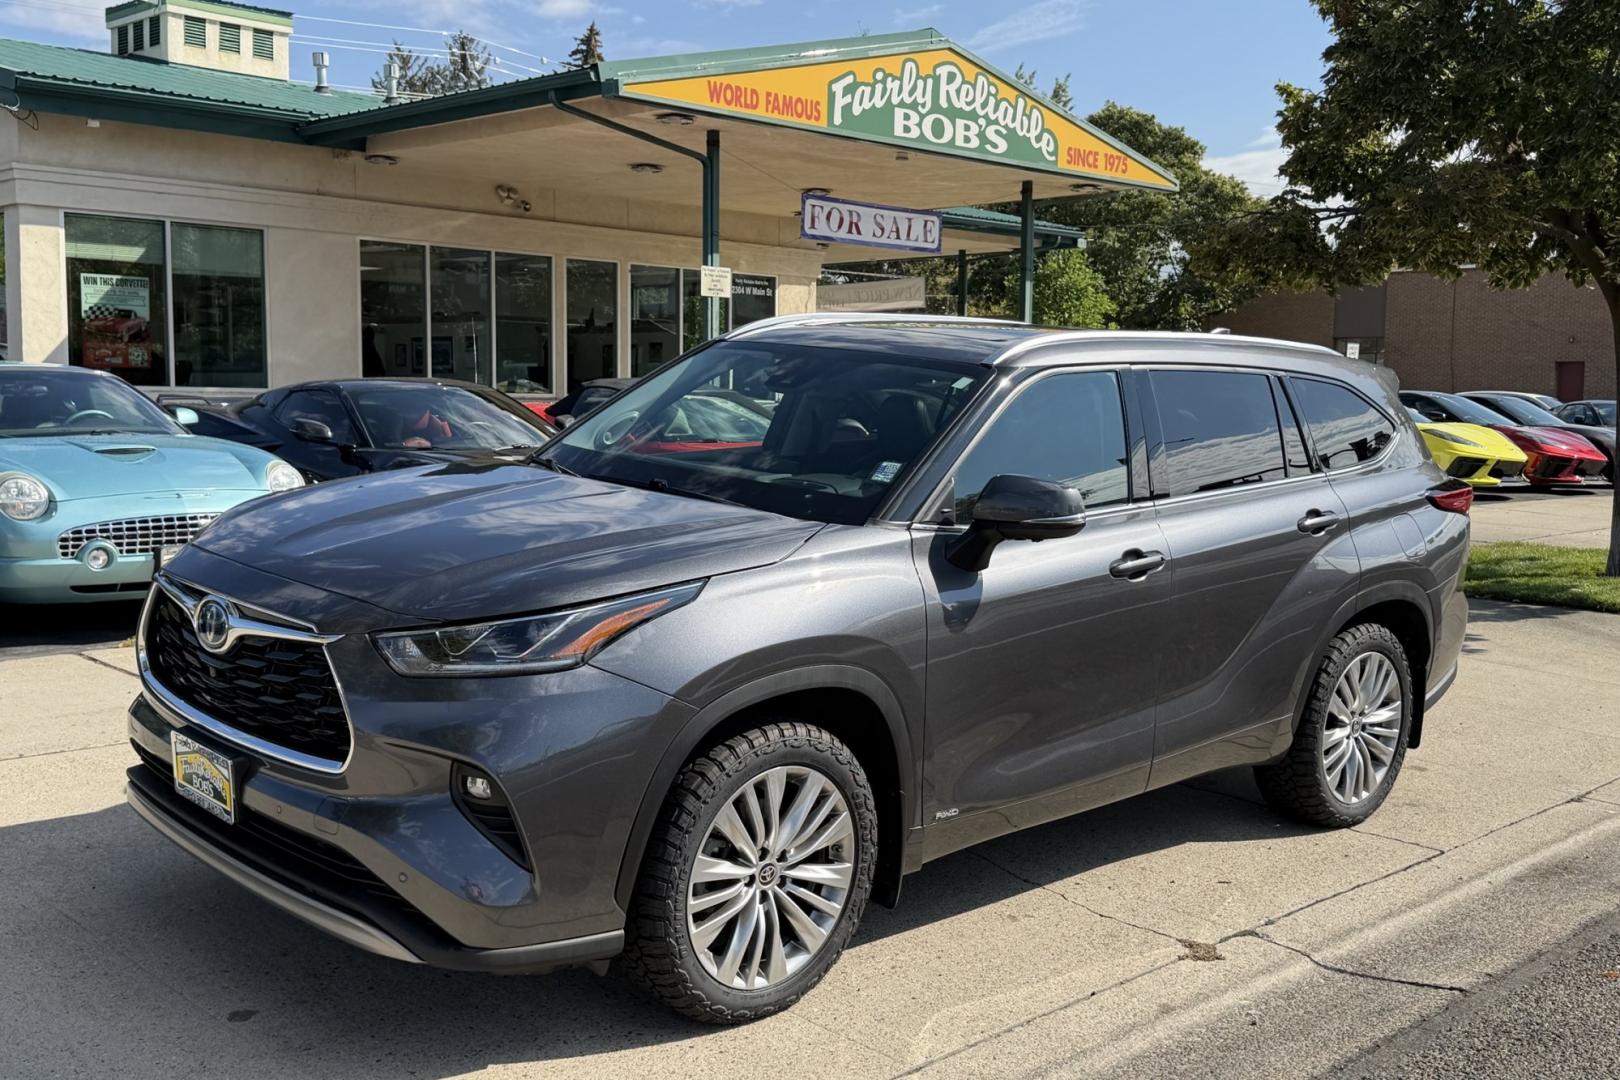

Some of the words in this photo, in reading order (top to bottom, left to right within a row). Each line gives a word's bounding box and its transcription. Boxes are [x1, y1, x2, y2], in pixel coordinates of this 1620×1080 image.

[706, 79, 760, 110] WORLD
[765, 91, 821, 122] FAMOUS
[831, 61, 933, 126] Fairly
[935, 64, 1056, 161] Reliable
[893, 107, 1008, 154] BOB'S
[1066, 146, 1099, 169] SINCE
[1104, 152, 1128, 174] 1975
[807, 203, 862, 236] FOR
[871, 212, 936, 244] SALE
[83, 275, 98, 285] WIN
[99, 276, 114, 287] THIS
[752, 287, 765, 296] Main
